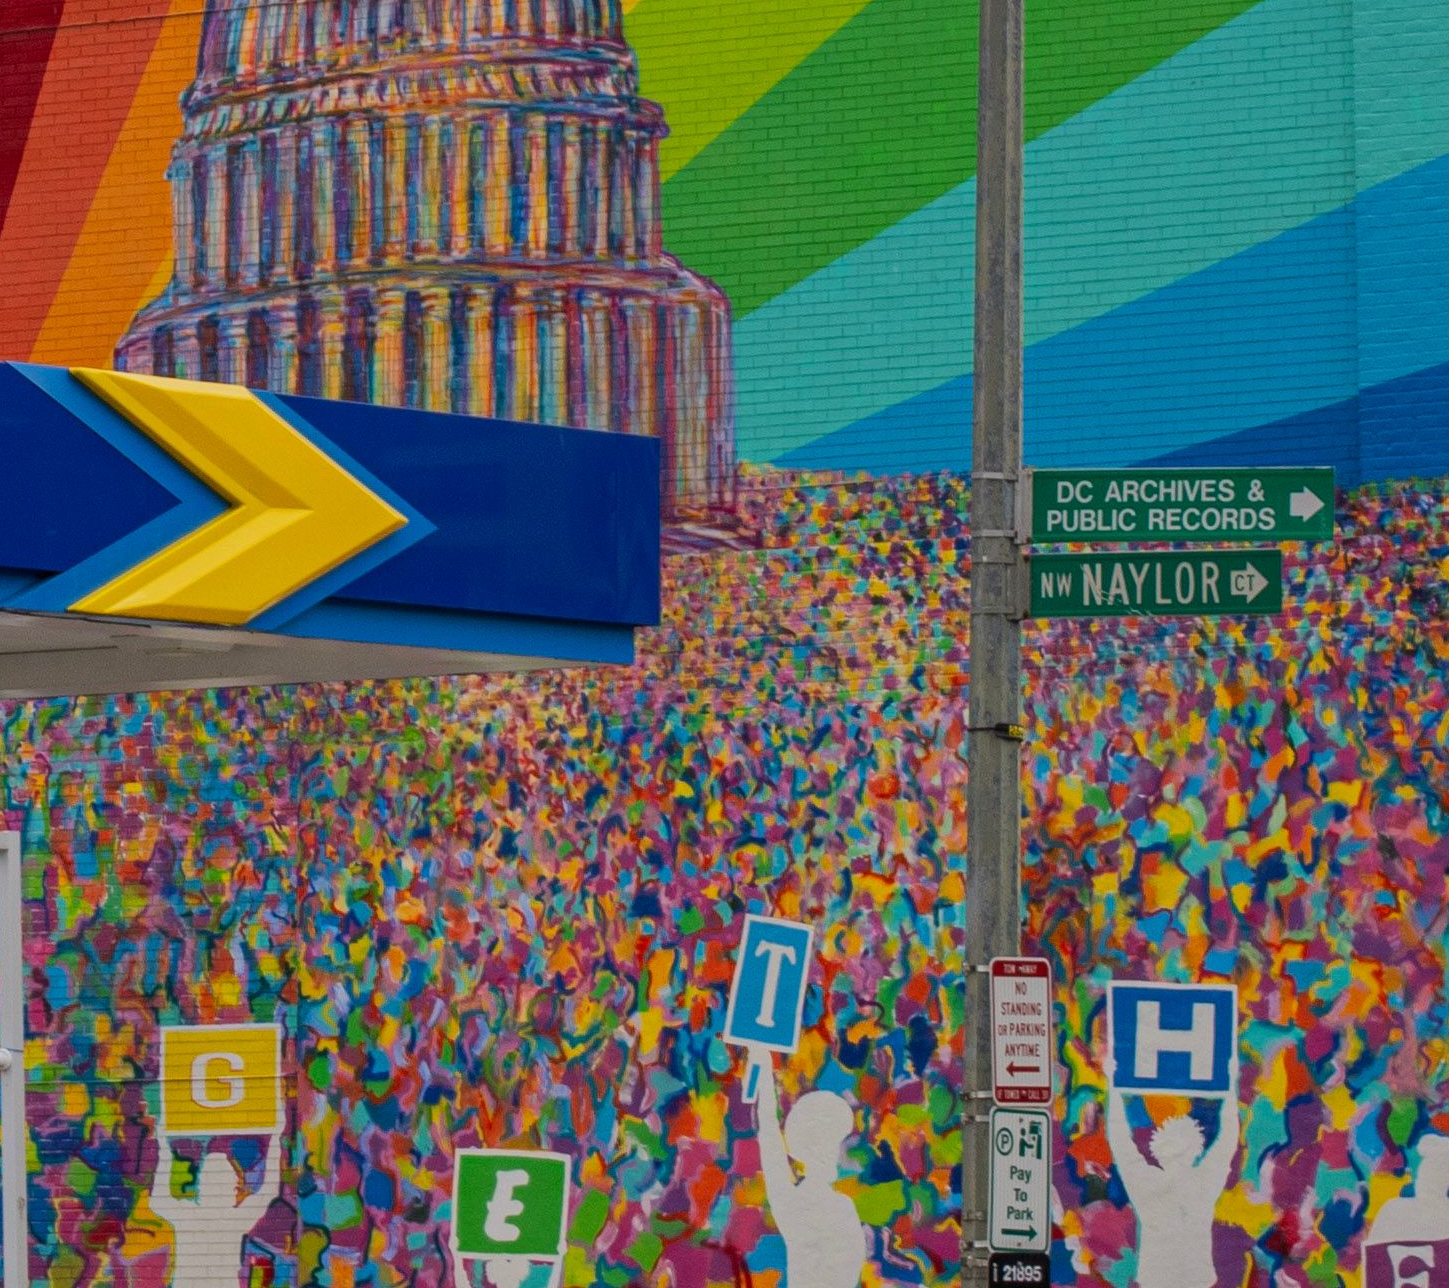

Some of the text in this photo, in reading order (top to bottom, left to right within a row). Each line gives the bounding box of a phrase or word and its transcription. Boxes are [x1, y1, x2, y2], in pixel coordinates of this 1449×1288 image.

[1056, 478, 1266, 504] DC ARCHIVES &
[1046, 507, 1276, 532] PUBLIC RECORDS
[1040, 562, 1255, 606] NW NAYLOR CT
[755, 938, 797, 1028] T
[1014, 982, 1027, 995] NO
[1001, 1002, 1042, 1016] STANDING
[998, 1023, 1046, 1037] OR PARKING
[1004, 1043, 1040, 1057] ANYTIME
[1134, 999, 1216, 1082] H
[190, 1051, 245, 1110] G
[1010, 1165, 1033, 1184] Pay
[1013, 1188, 1028, 1202] To
[1006, 1206, 1034, 1221] Park
